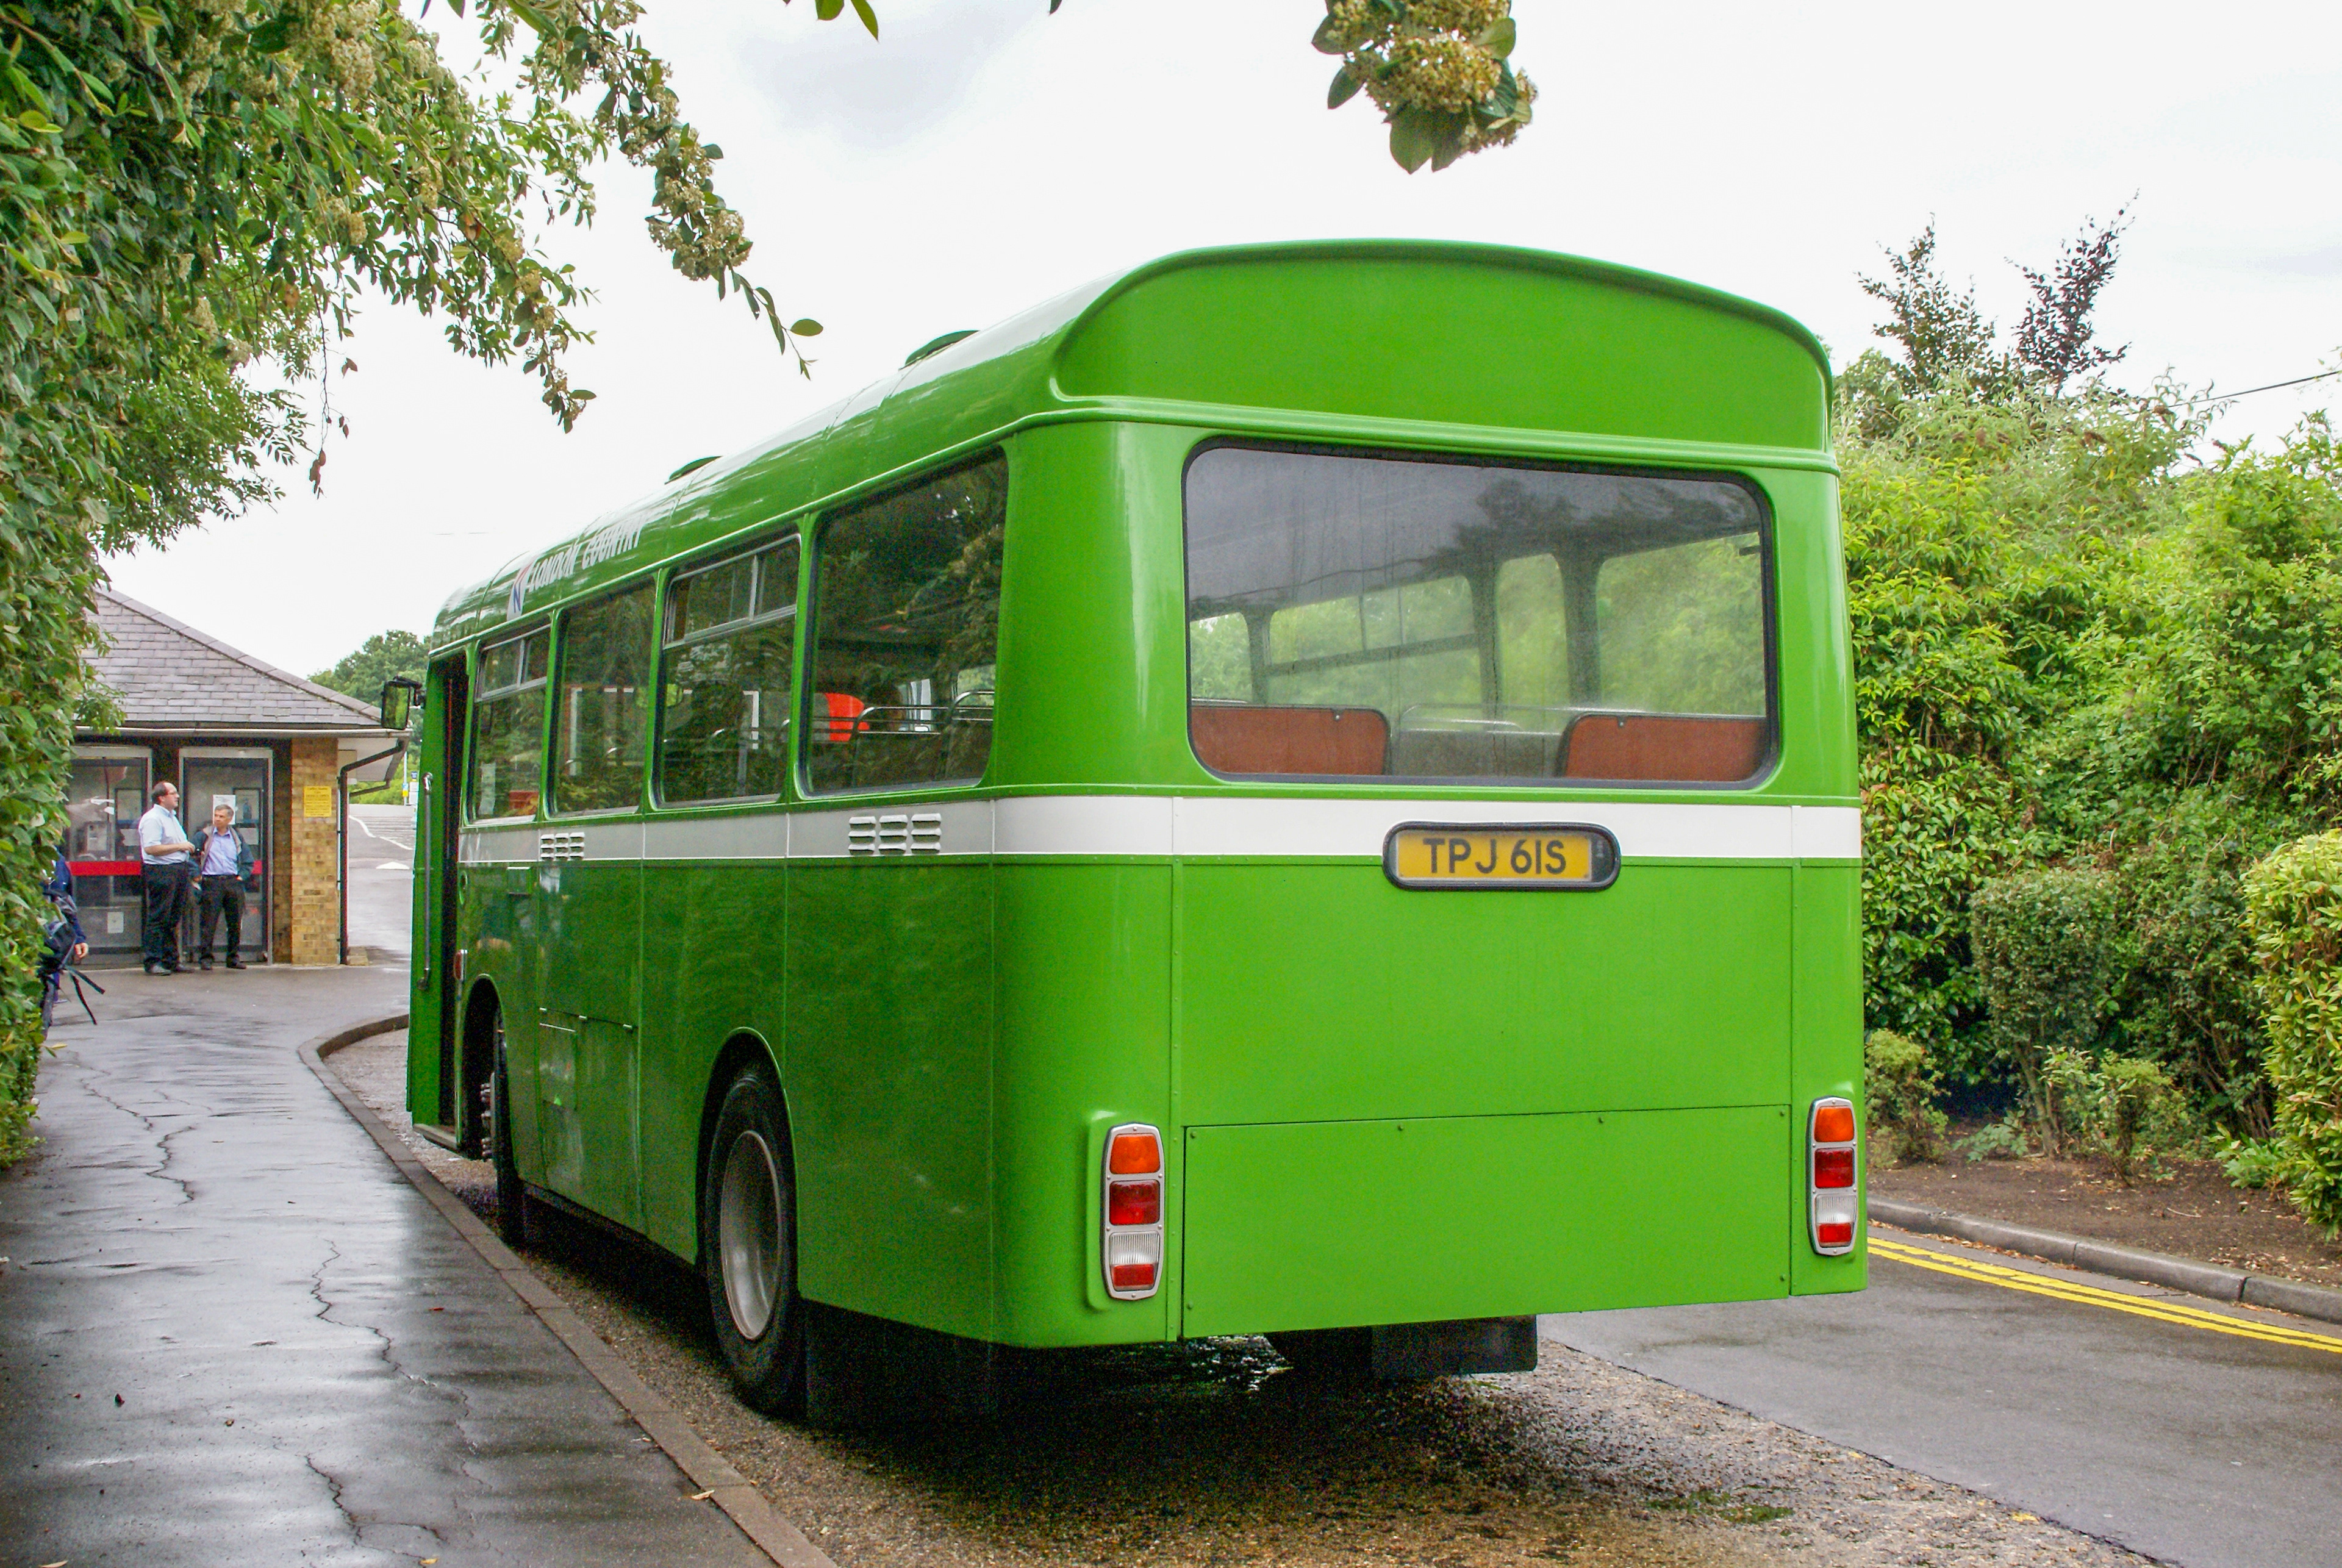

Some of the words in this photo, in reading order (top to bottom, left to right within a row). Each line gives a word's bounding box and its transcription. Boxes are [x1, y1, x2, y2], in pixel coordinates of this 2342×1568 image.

[526, 540, 582, 593] LONDON
[582, 514, 648, 570] COUNTRY
[1422, 837, 1497, 874] TPJ
[1510, 839, 1567, 875] 61S
